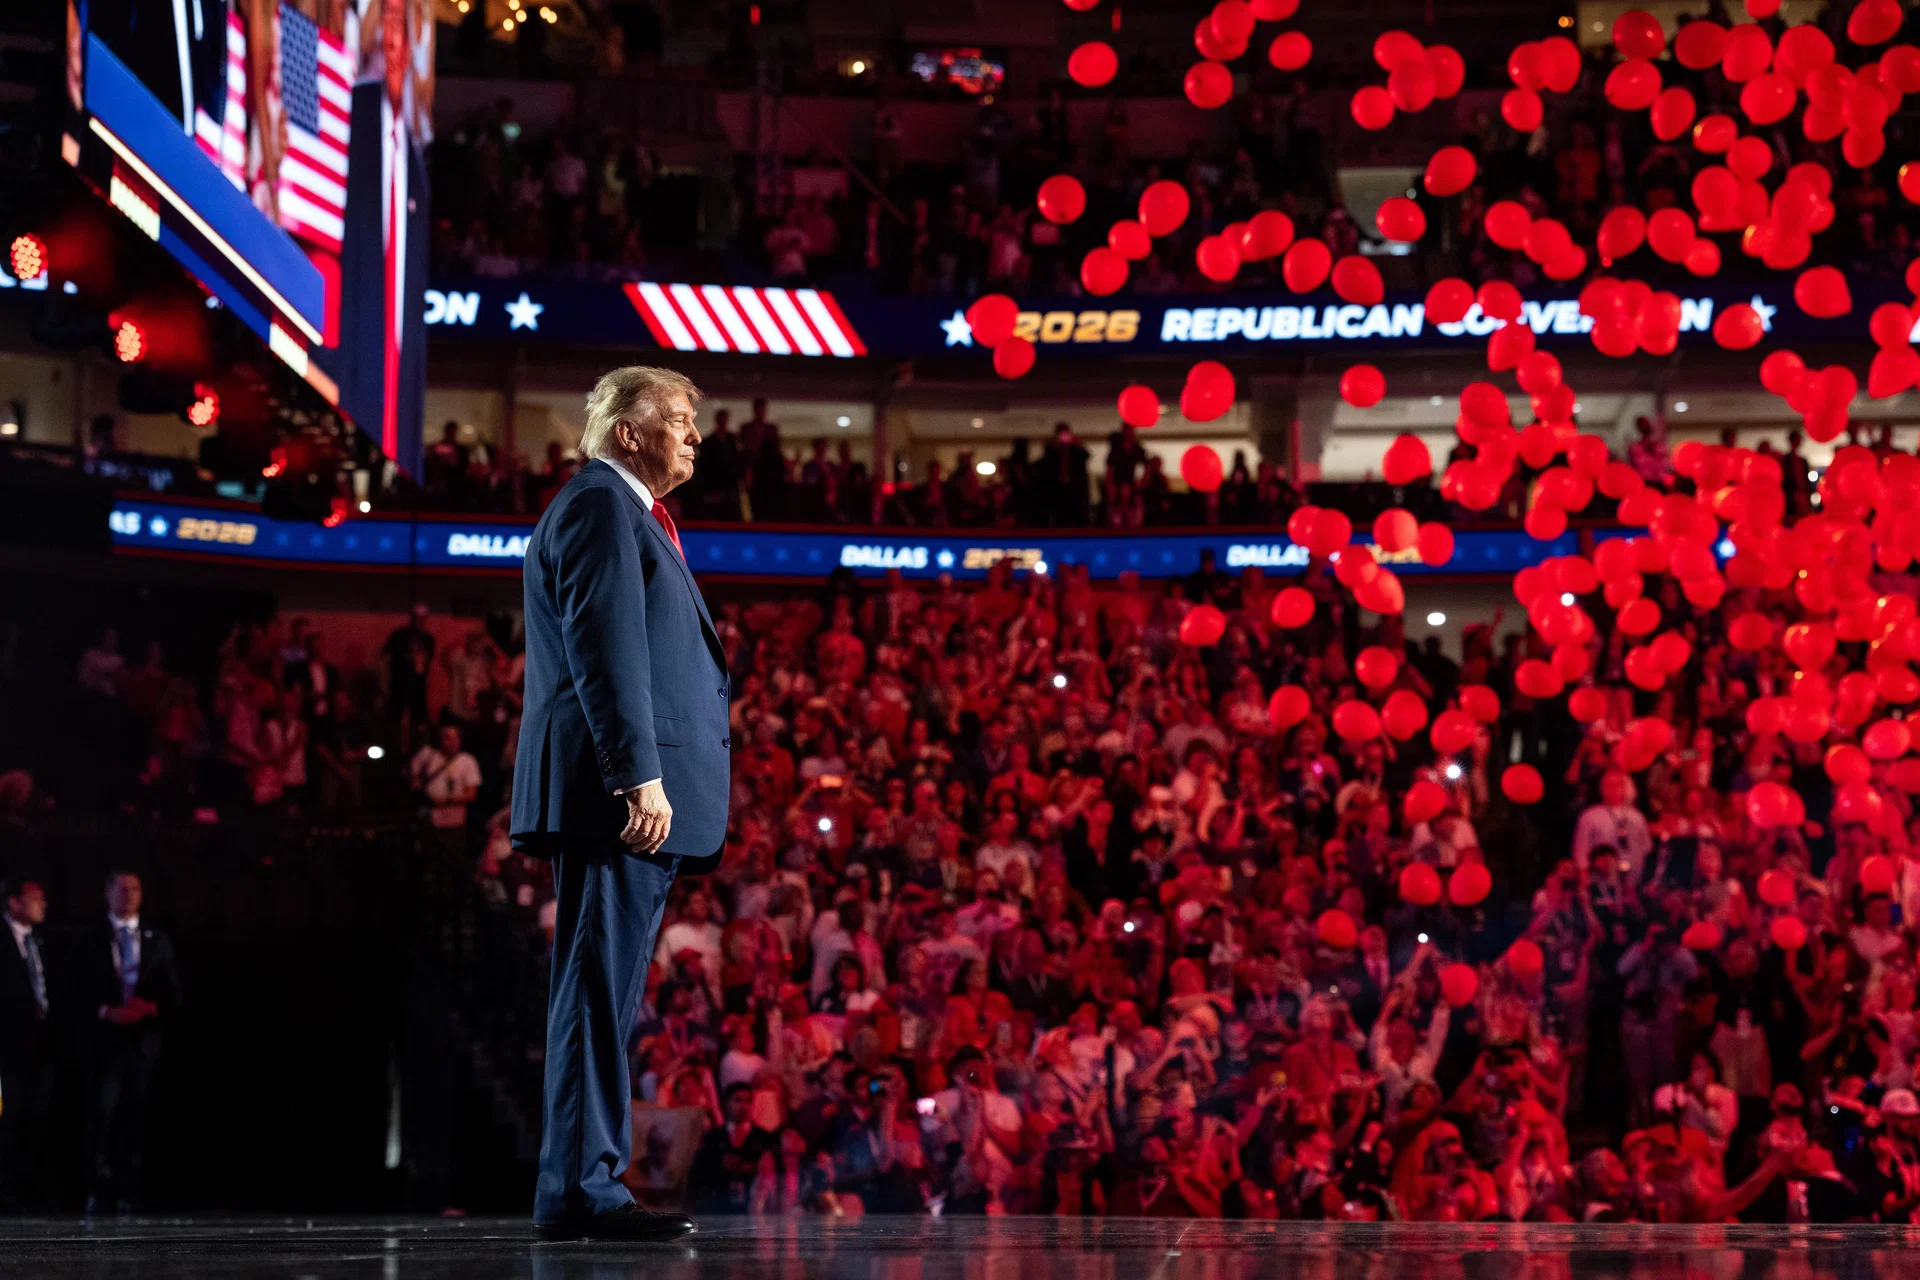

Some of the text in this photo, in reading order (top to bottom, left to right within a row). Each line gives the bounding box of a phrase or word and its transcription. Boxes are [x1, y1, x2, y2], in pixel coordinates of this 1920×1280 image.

[1012, 309, 1141, 343] 2026
[1160, 303, 1425, 342] REPUBLICAN
[176, 517, 258, 545] 2026
[840, 545, 928, 569] DALLAS
